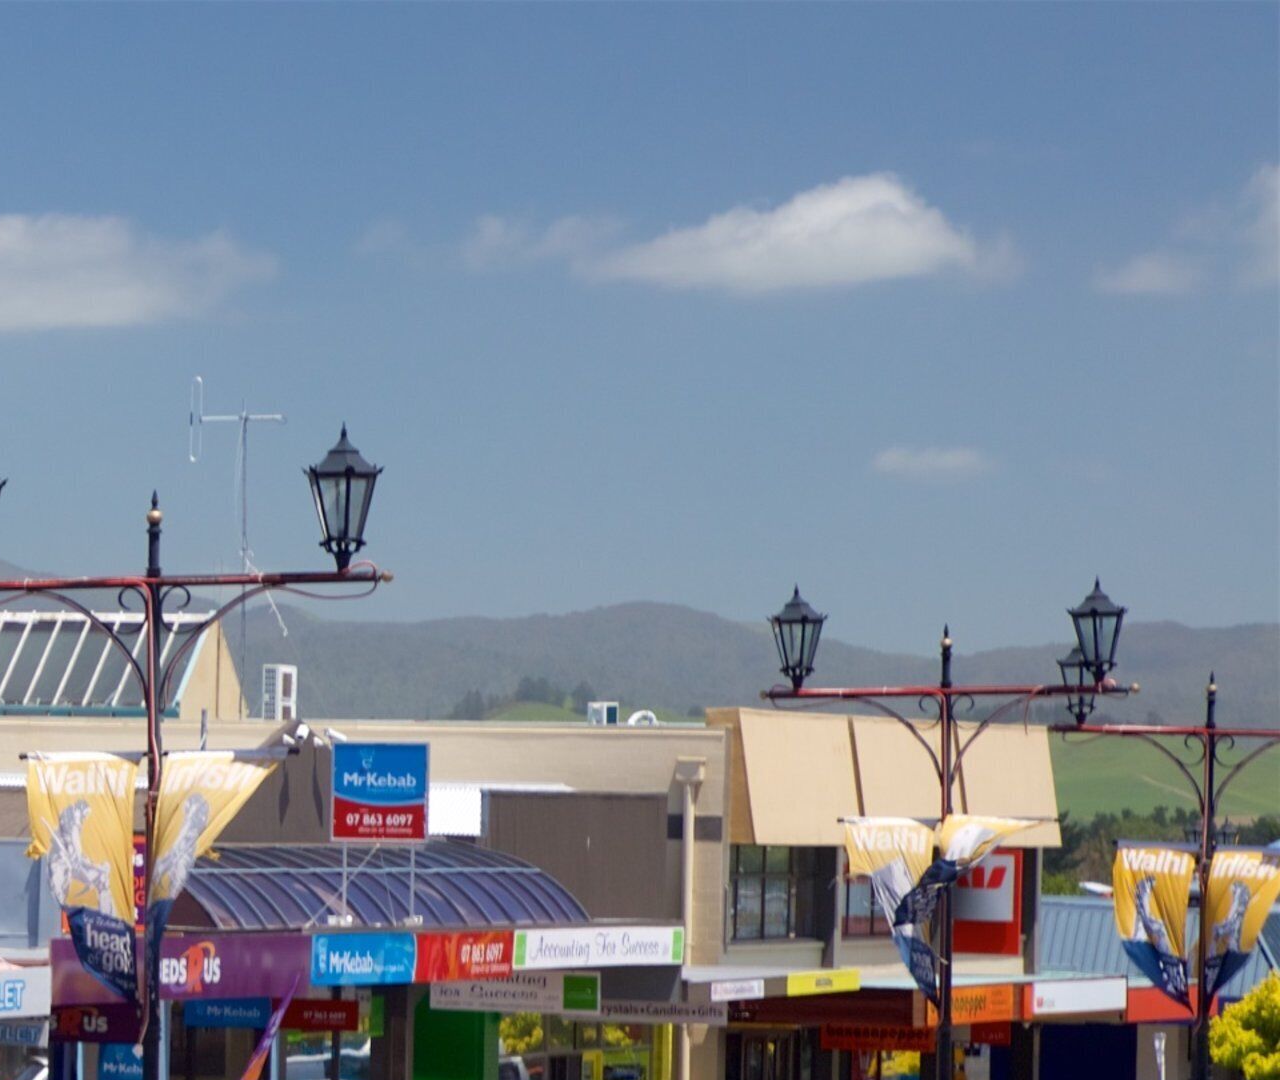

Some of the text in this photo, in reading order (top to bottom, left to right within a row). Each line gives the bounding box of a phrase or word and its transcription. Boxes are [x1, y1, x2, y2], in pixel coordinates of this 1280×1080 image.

[38, 763, 130, 797] Waihi
[343, 771, 416, 788] MrKebab
[346, 813, 413, 826] 07 863 6097
[1121, 848, 1189, 875] Waihi
[529, 936, 591, 964] Accounting
[621, 933, 660, 956] Success
[202, 956, 221, 984] US
[329, 951, 374, 974] MrKebab
[600, 1003, 640, 1017] rystals
[83, 1014, 109, 1033] US
